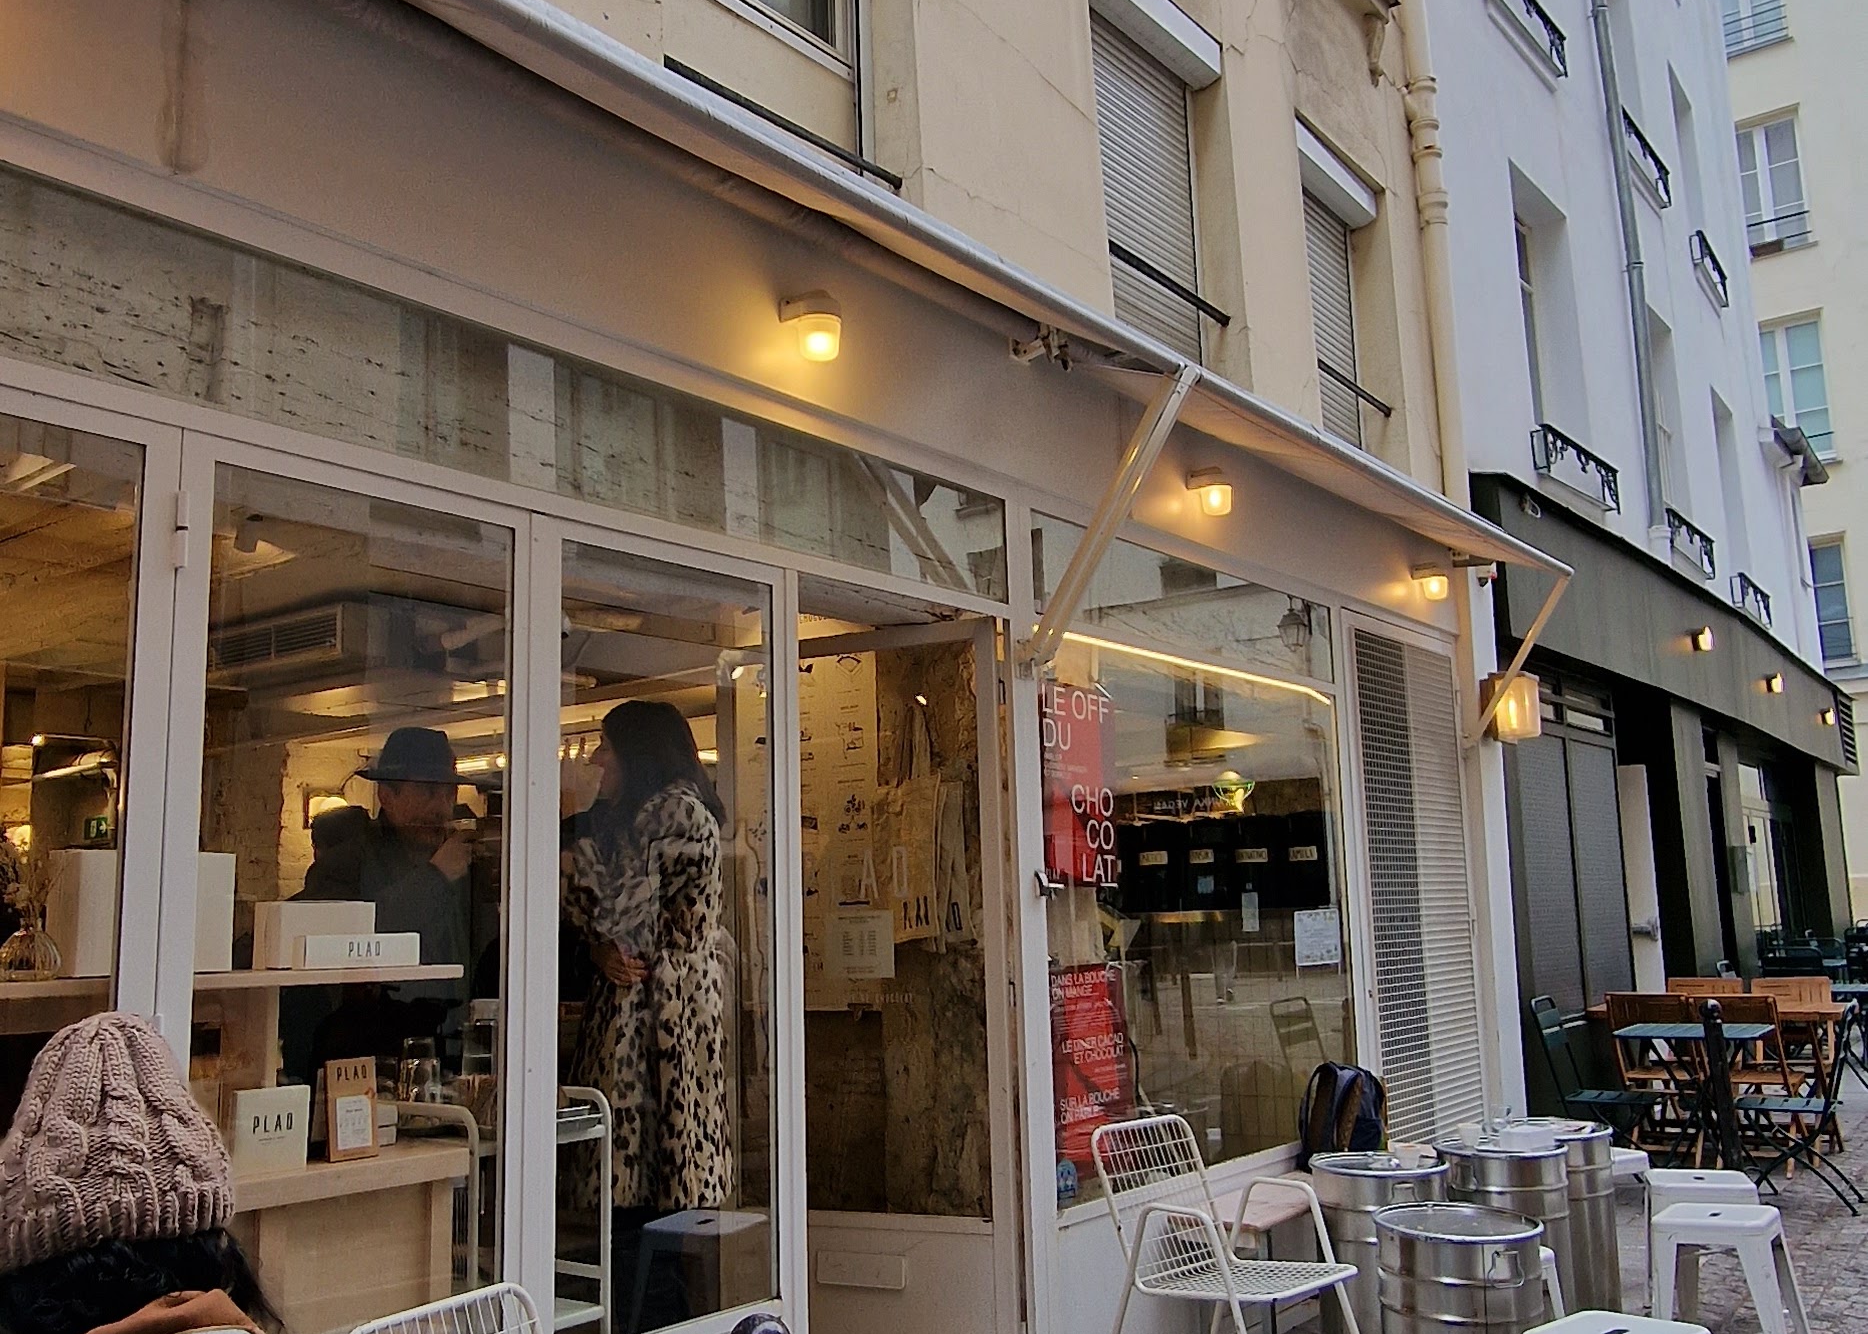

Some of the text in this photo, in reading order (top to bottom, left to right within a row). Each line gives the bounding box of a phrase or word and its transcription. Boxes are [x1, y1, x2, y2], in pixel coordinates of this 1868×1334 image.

[1041, 683, 1110, 724] LE OFF
[1043, 718, 1072, 751] DU
[1071, 784, 1115, 817] CHO
[1086, 819, 1115, 850] CO
[1082, 853, 1116, 883] LAT
[1073, 972, 1084, 985] LA
[1084, 969, 1117, 984] BOUCHE
[1051, 987, 1065, 1001] ON
[1061, 1038, 1073, 1054] LE
[1097, 1032, 1124, 1047] CACAO
[1073, 1044, 1124, 1065] ET CHOCOLAT
[1060, 1086, 1121, 1112] SUR LA BOUCHE
[1060, 1109, 1074, 1125] ON
